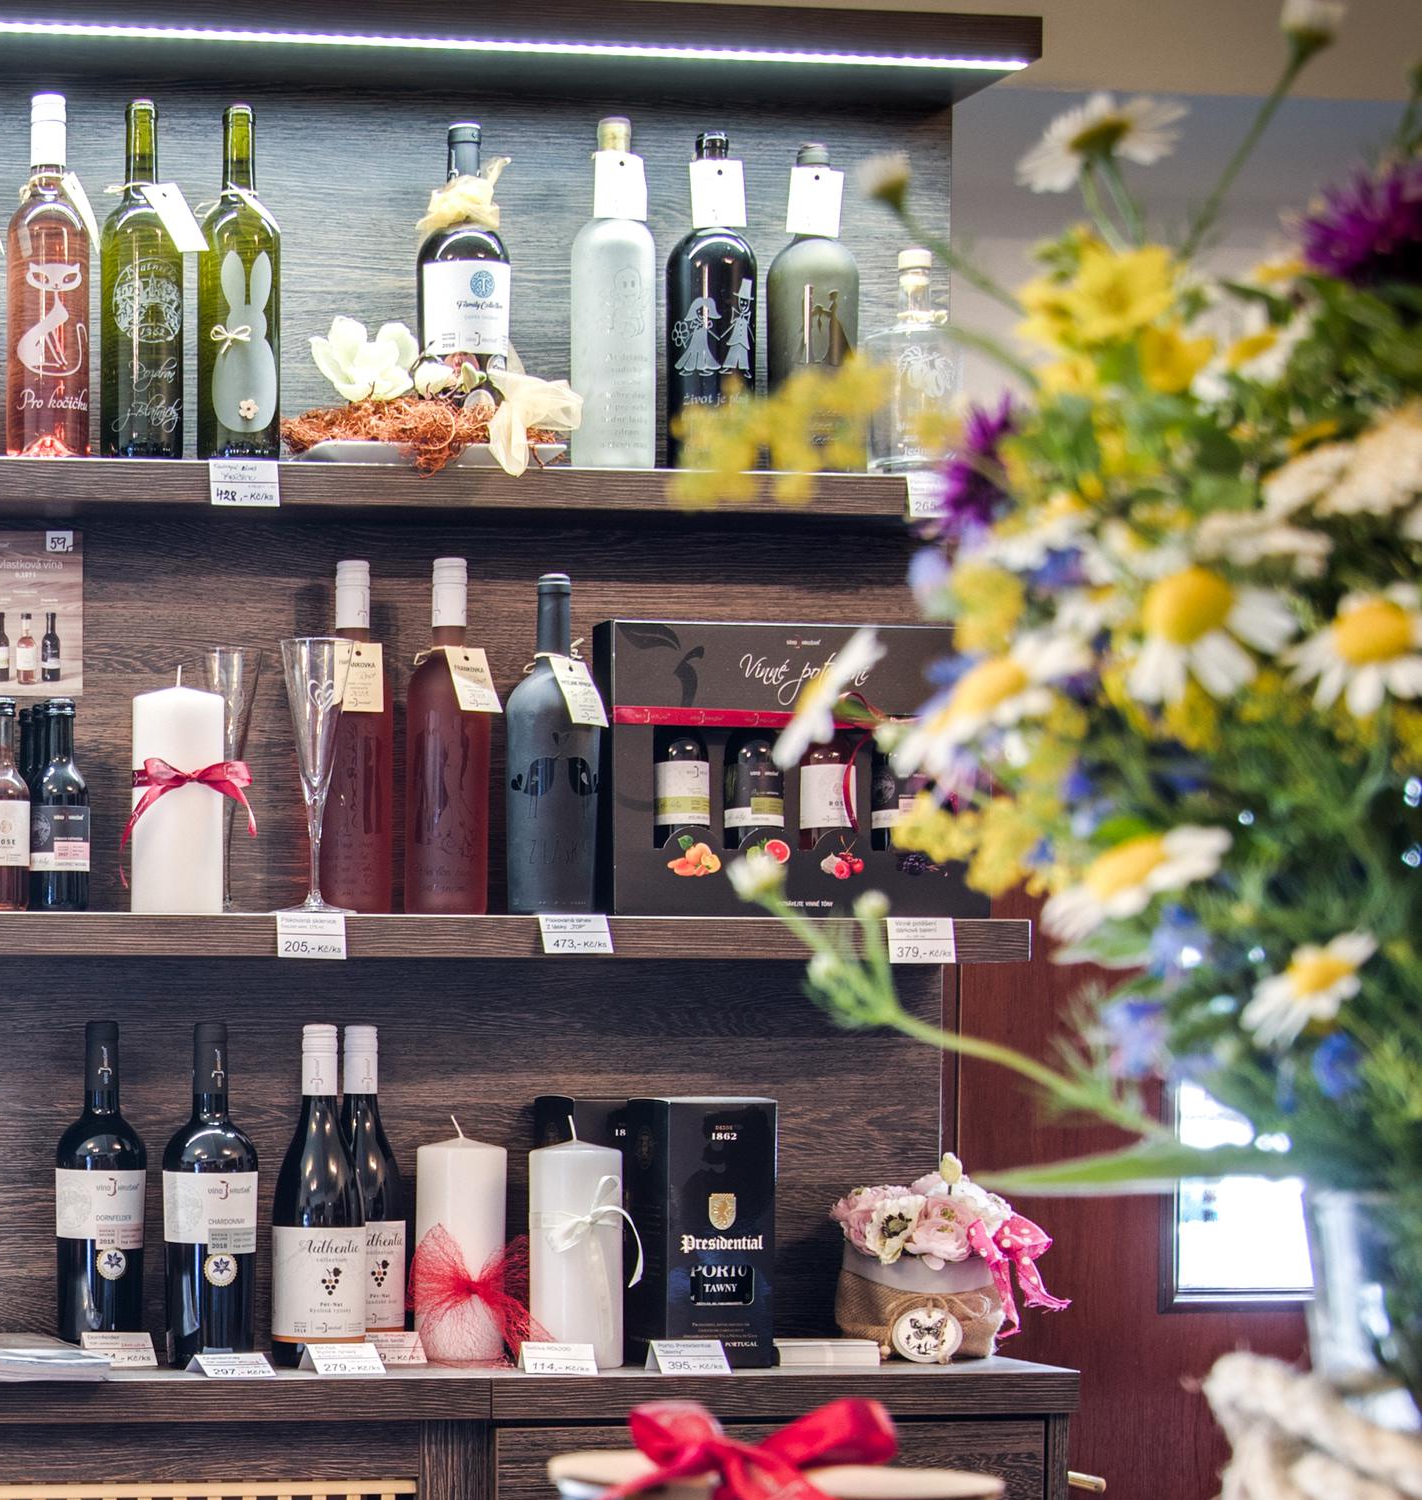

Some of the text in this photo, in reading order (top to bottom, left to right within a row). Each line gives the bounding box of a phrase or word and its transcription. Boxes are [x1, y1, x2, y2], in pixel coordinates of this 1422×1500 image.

[16, 386, 88, 412] Pro kočičku
[683, 392, 727, 408] Život je
[43, 560, 64, 570] vína
[739, 653, 791, 685] Vinné
[284, 940, 342, 954] 205,- Kč/ks
[553, 938, 608, 950] 473,- Kč/ks
[897, 946, 953, 959] 379,- Kč/ks
[710, 1132, 738, 1141] 1862
[95, 1214, 133, 1222] DORNFELDER
[208, 1218, 246, 1226] CHARDONNAY
[366, 1231, 404, 1249] uthentic
[679, 1234, 764, 1254] Presidential
[211, 1242, 228, 1250] 2018
[298, 1238, 361, 1255] Authentic
[702, 1283, 738, 1293] TAWNY
[86, 1334, 120, 1342] Dornfelder
[724, 1340, 759, 1348] PORTUGAL
[127, 1354, 152, 1362] Kč/ks
[323, 1362, 382, 1373] 279,- Kč/ks
[532, 1362, 590, 1373] 114,- Kč/ks
[667, 1360, 724, 1372] 395,- Kč/ks
[212, 1367, 271, 1377] 297,- Kč/ks
